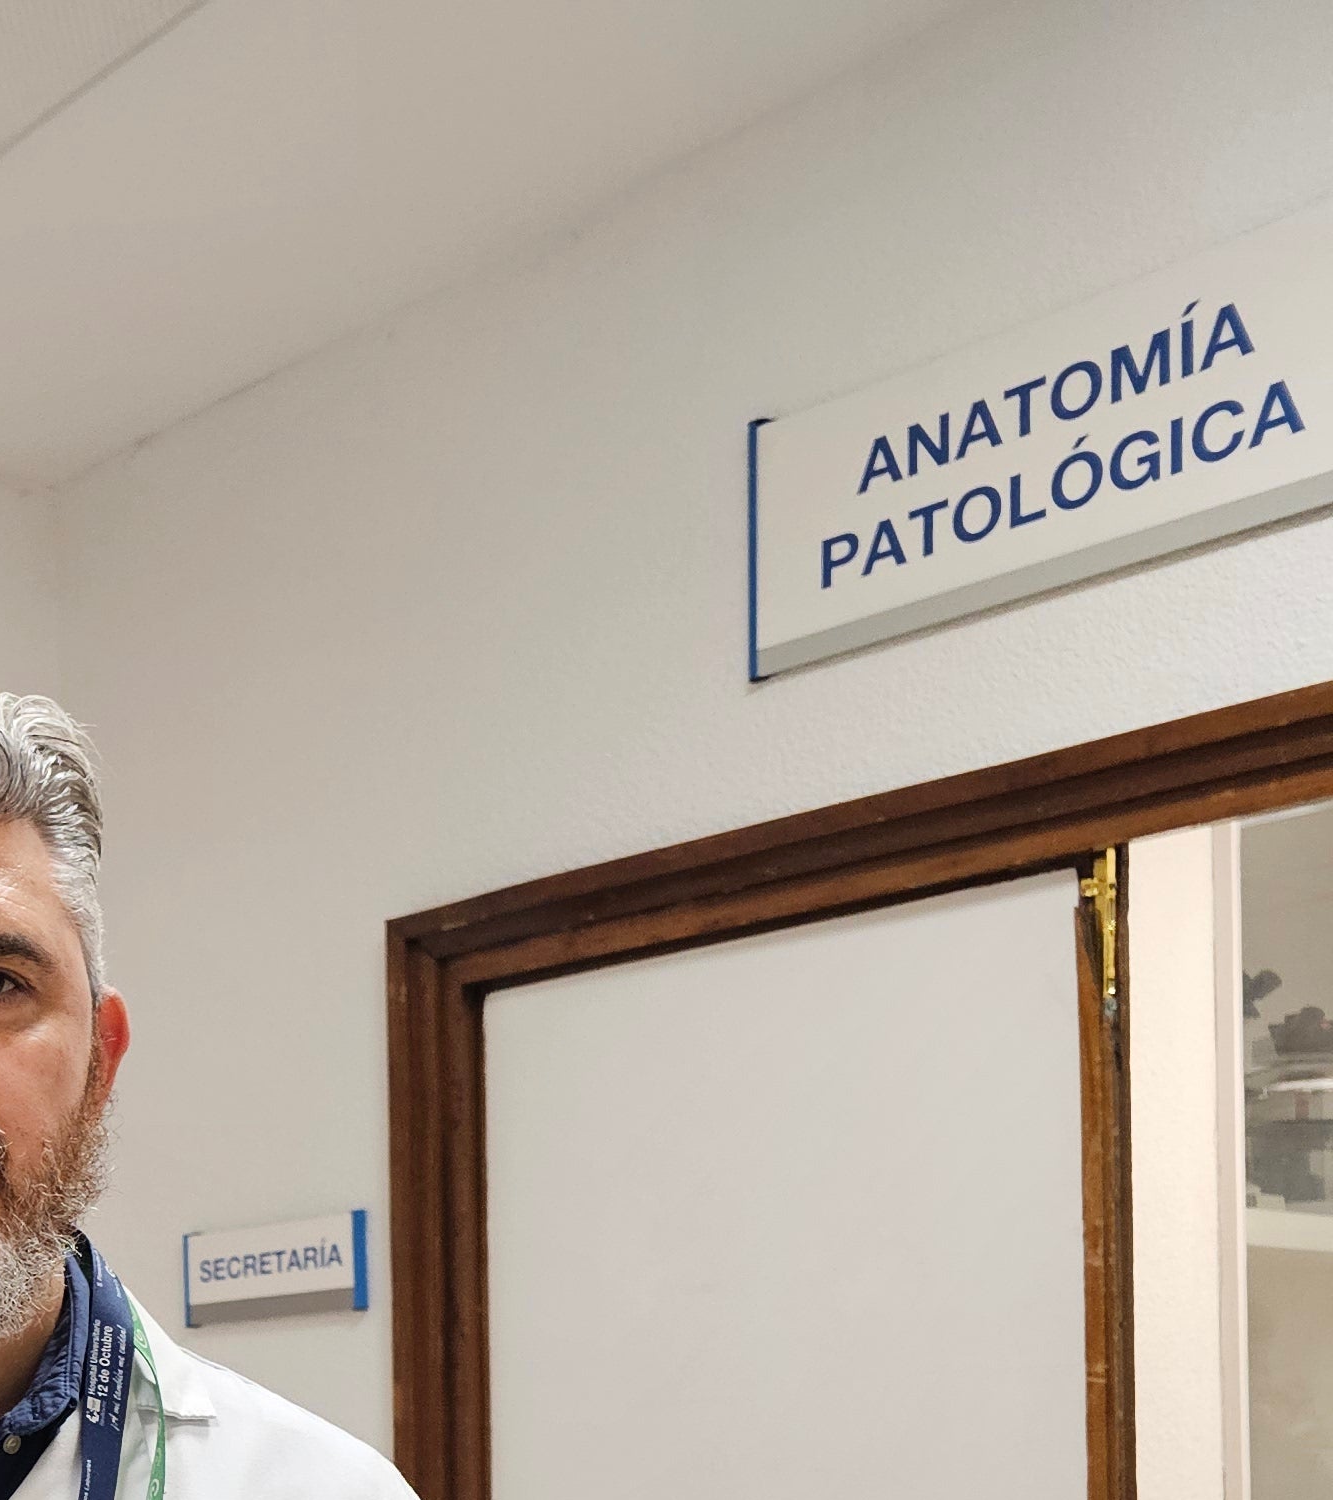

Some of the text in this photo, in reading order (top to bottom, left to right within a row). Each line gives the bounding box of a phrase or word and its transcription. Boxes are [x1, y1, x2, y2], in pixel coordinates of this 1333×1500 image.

[857, 299, 1254, 495] ANATOMÍA
[820, 380, 1306, 589] PATOLÓGICA
[199, 1238, 343, 1283] SECRETARÍA
[99, 1325, 113, 1366] Octubre
[97, 1381, 108, 1397] 12
